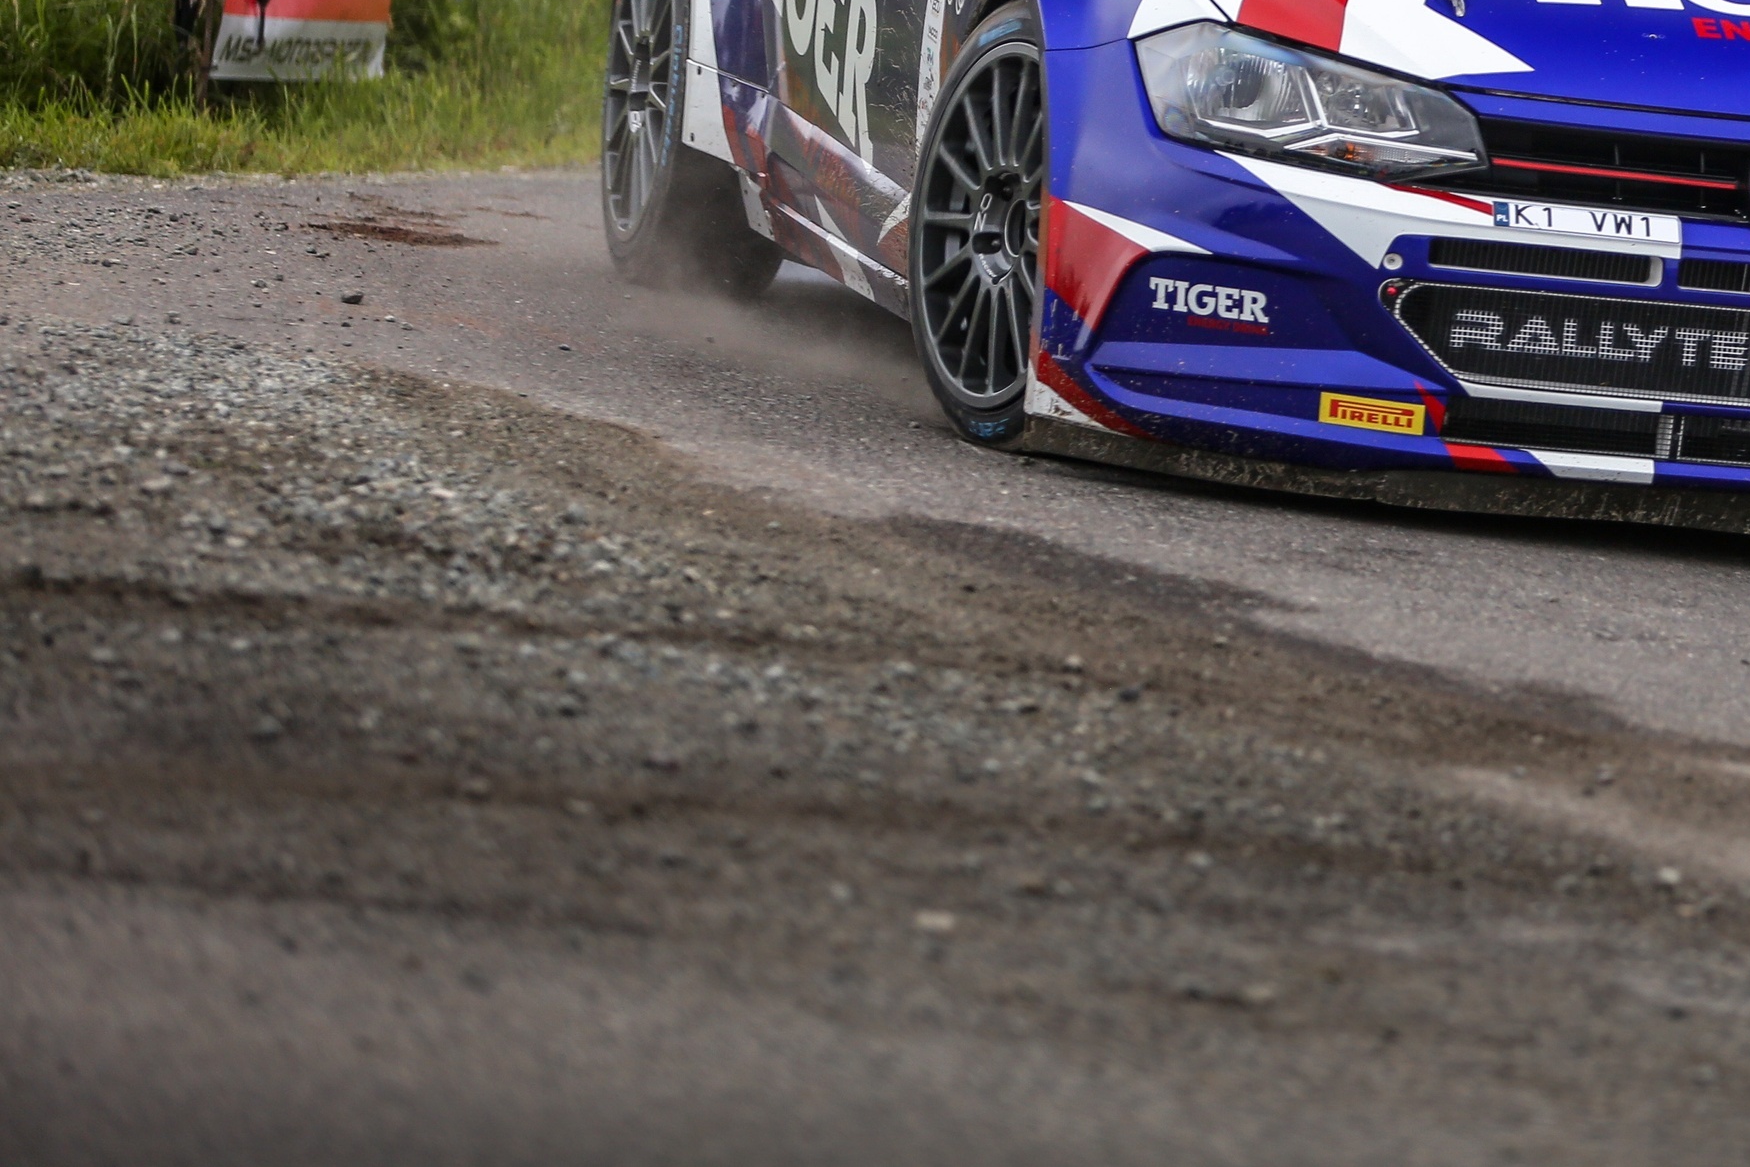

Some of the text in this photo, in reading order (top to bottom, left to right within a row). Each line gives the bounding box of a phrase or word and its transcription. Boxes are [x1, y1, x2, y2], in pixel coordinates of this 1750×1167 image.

[1496, 214, 1508, 222] PL
[1589, 212, 1650, 237] VW1
[1149, 276, 1270, 324] TIGER
[1329, 398, 1414, 429] PIRELLI
